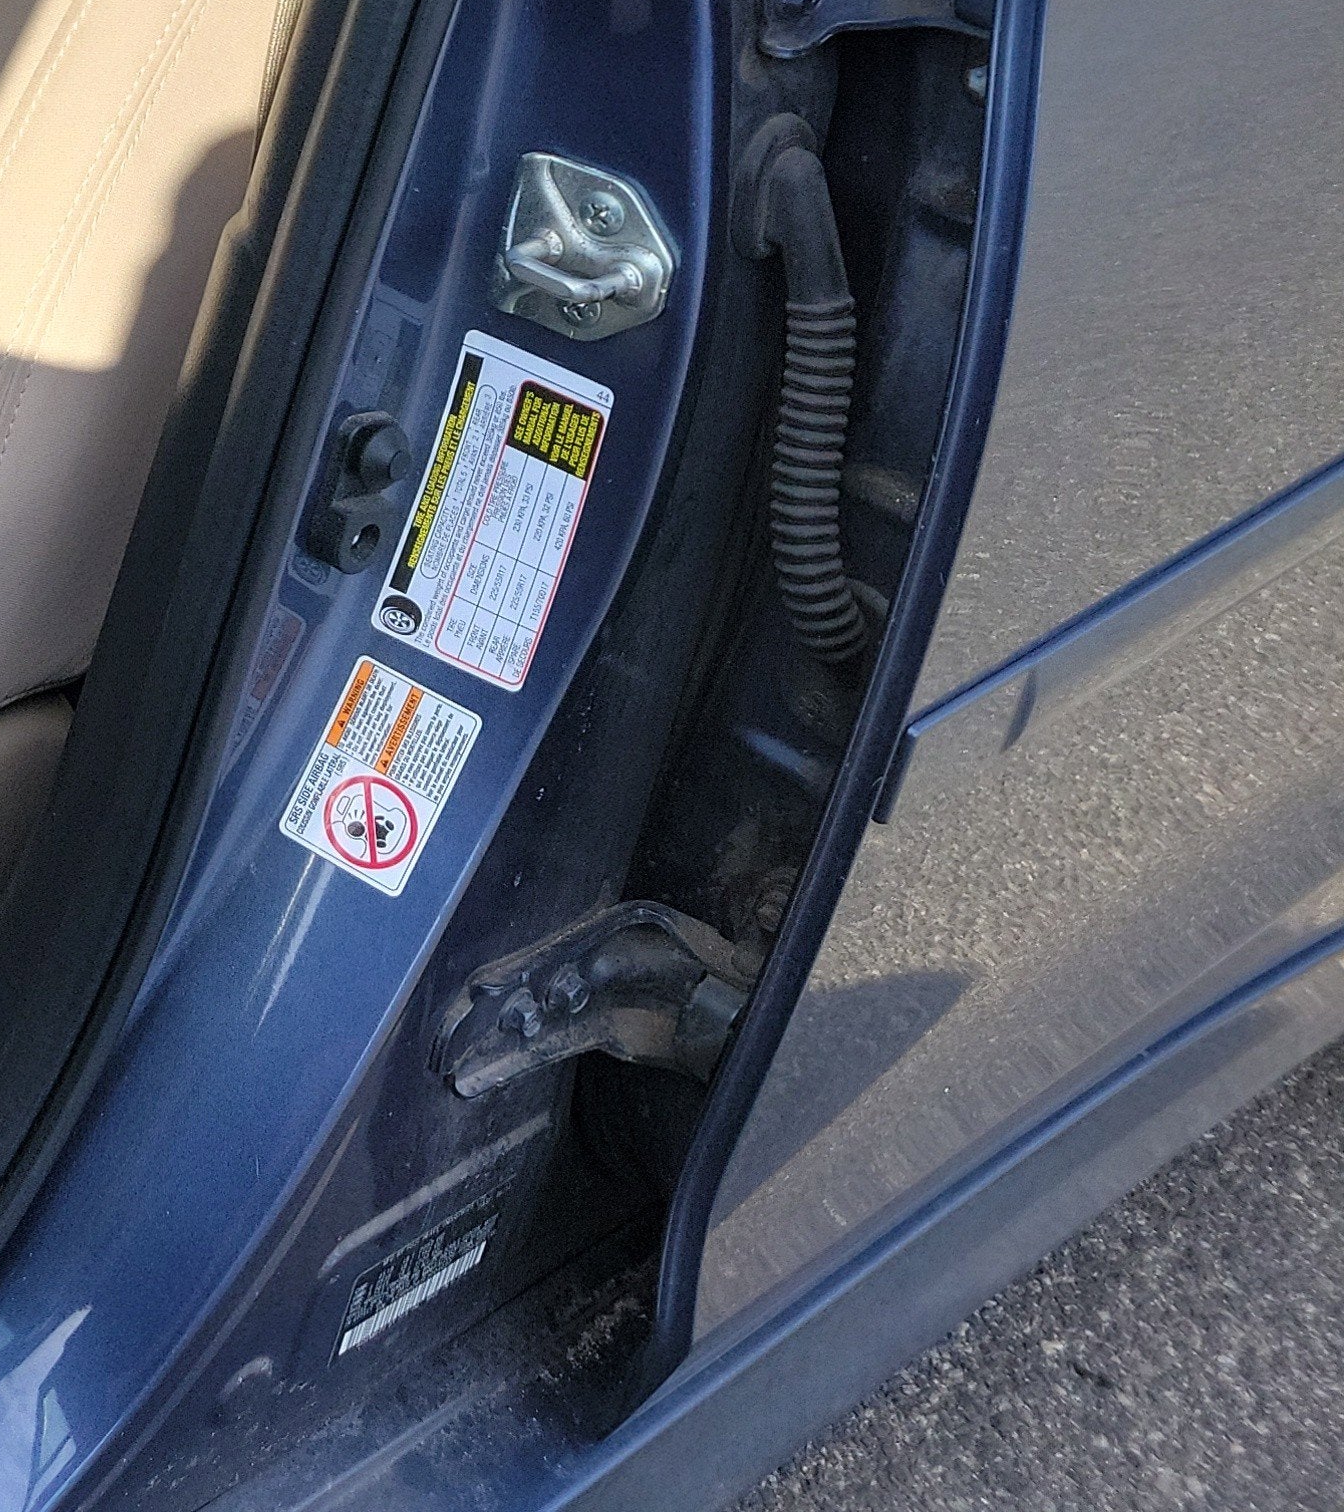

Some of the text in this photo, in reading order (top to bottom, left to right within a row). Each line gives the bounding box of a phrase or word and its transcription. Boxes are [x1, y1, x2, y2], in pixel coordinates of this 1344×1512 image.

[595, 389, 610, 402] 44
[471, 407, 482, 425] REAR
[513, 389, 535, 440] SEE OWNER'S
[521, 396, 543, 444] MANUAL FOR
[530, 400, 552, 445] ADDITIONAL
[537, 401, 562, 452] INFORMATION
[548, 401, 574, 463] VOIR LE MANUEL
[460, 440, 472, 462] FRONT
[560, 448, 570, 460] DE
[567, 413, 590, 467] POUR PLUS DE
[573, 410, 603, 477] RENSEIGNEMENTS
[407, 381, 476, 569] RENSEIGNEMENTS SUR LES PNEUS ET LE CHARGEMENT
[413, 413, 457, 528] TIRE AND LOADING INFORMATION
[524, 482, 533, 494] PSI
[481, 459, 508, 526] COLD TIRE PRESSURE
[491, 472, 511, 519] PRESSION DES
[521, 493, 530, 504] 33
[541, 502, 550, 513] 32
[544, 491, 554, 504] PSI
[565, 501, 574, 513] PSI
[512, 518, 522, 532] 230
[532, 527, 543, 542] 220
[562, 512, 571, 523] 60
[423, 505, 450, 568] SEATING CAPACITY
[430, 504, 459, 571] NOMBRE DE PLACES
[553, 536, 563, 550] 420
[466, 562, 477, 579] SIZE
[470, 553, 490, 595] DIMENSIONS
[488, 564, 507, 601] 225/55R17
[509, 573, 527, 611] 225/55R17
[446, 617, 457, 633] TIRE
[454, 618, 466, 639] PNEU
[467, 623, 480, 647] FRONT
[475, 627, 488, 650] AVANT
[488, 634, 499, 654] REAR
[507, 642, 520, 665] SPARE
[512, 635, 532, 678] DE SECOURS
[342, 677, 364, 715] WARNING
[384, 693, 419, 756] AVERTISSEMENT
[288, 751, 329, 825] SRS SIDE AIRBAG
[296, 808, 313, 835] COUSSIN
[307, 776, 328, 810] GONFLABLE
